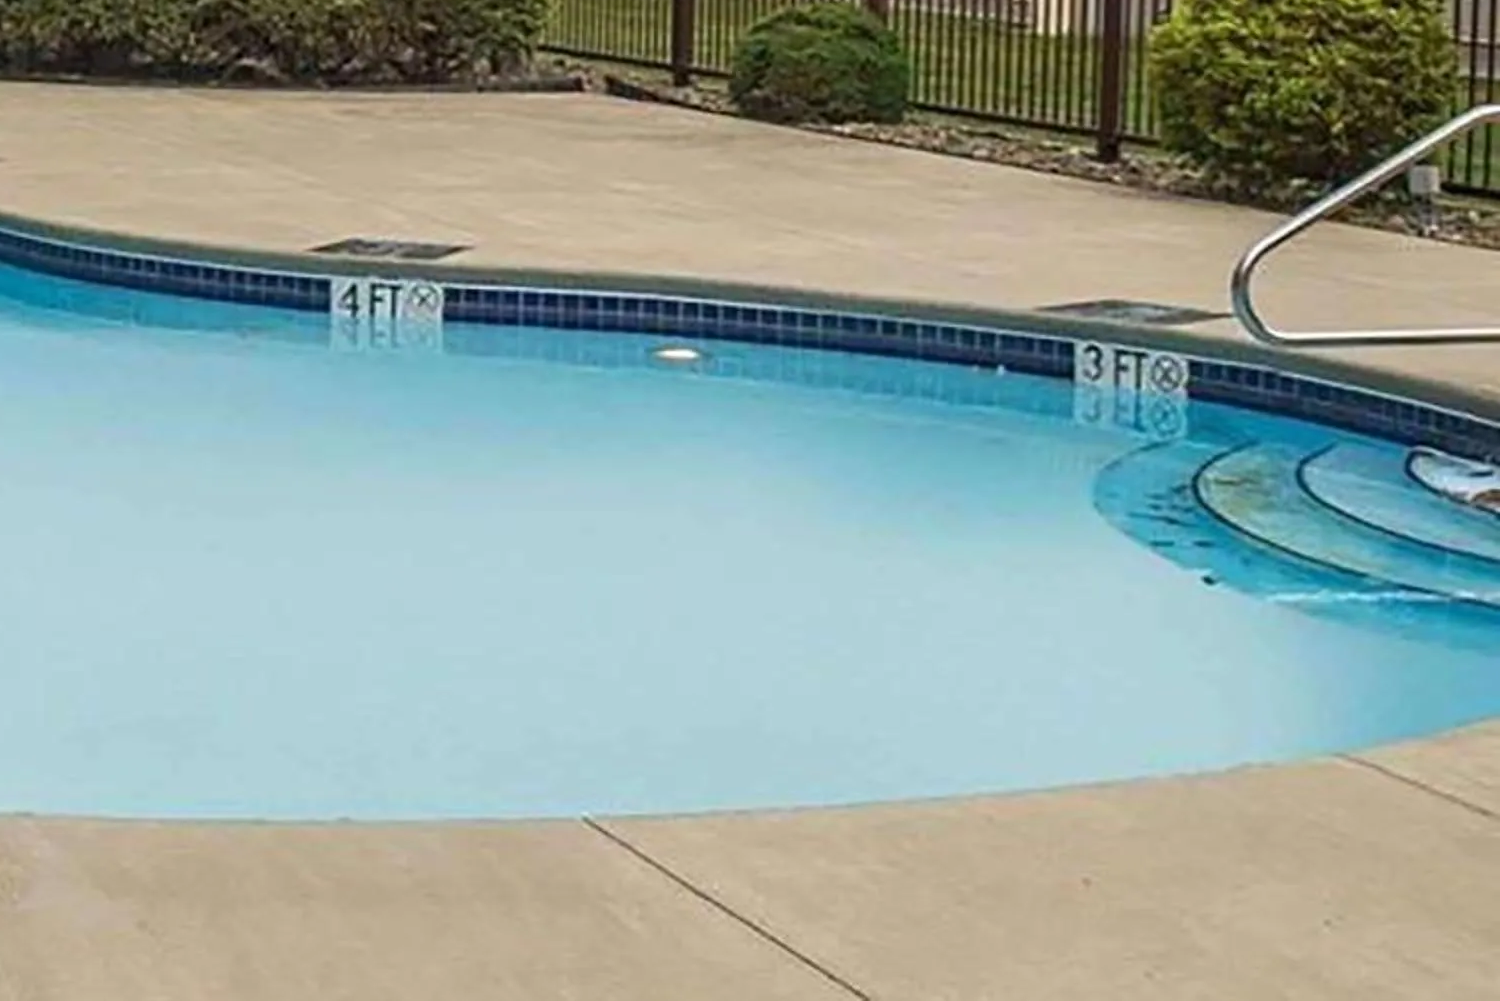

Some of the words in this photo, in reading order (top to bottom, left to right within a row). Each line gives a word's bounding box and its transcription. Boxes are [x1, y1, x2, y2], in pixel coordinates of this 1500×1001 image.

[339, 283, 360, 318] 4
[369, 283, 402, 319] FT
[1083, 345, 1104, 382] 3
[1114, 349, 1148, 390] FT
